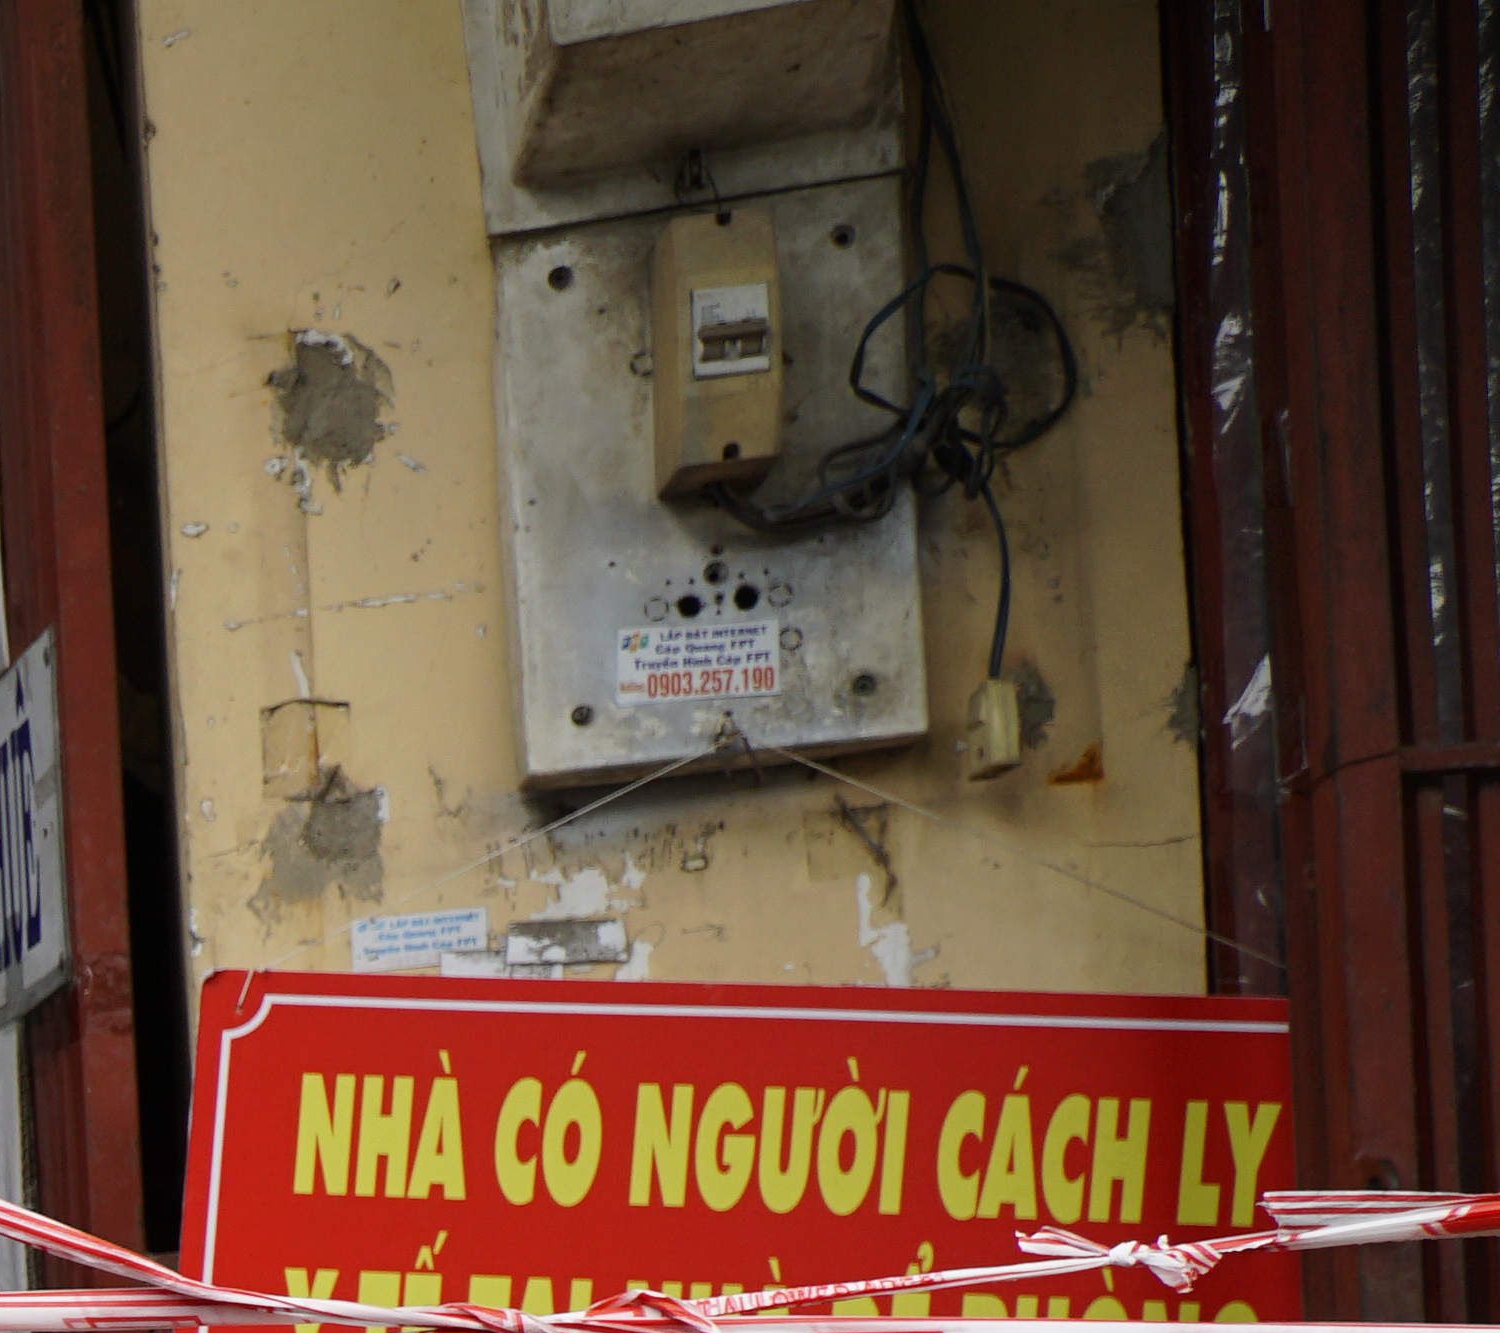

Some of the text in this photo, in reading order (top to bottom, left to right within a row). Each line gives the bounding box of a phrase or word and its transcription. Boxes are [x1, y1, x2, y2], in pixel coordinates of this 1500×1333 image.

[647, 666, 775, 698] 0903.257.190
[294, 1050, 1282, 1227] NHÀ CÓ NGƯỜI CÁCH LY
